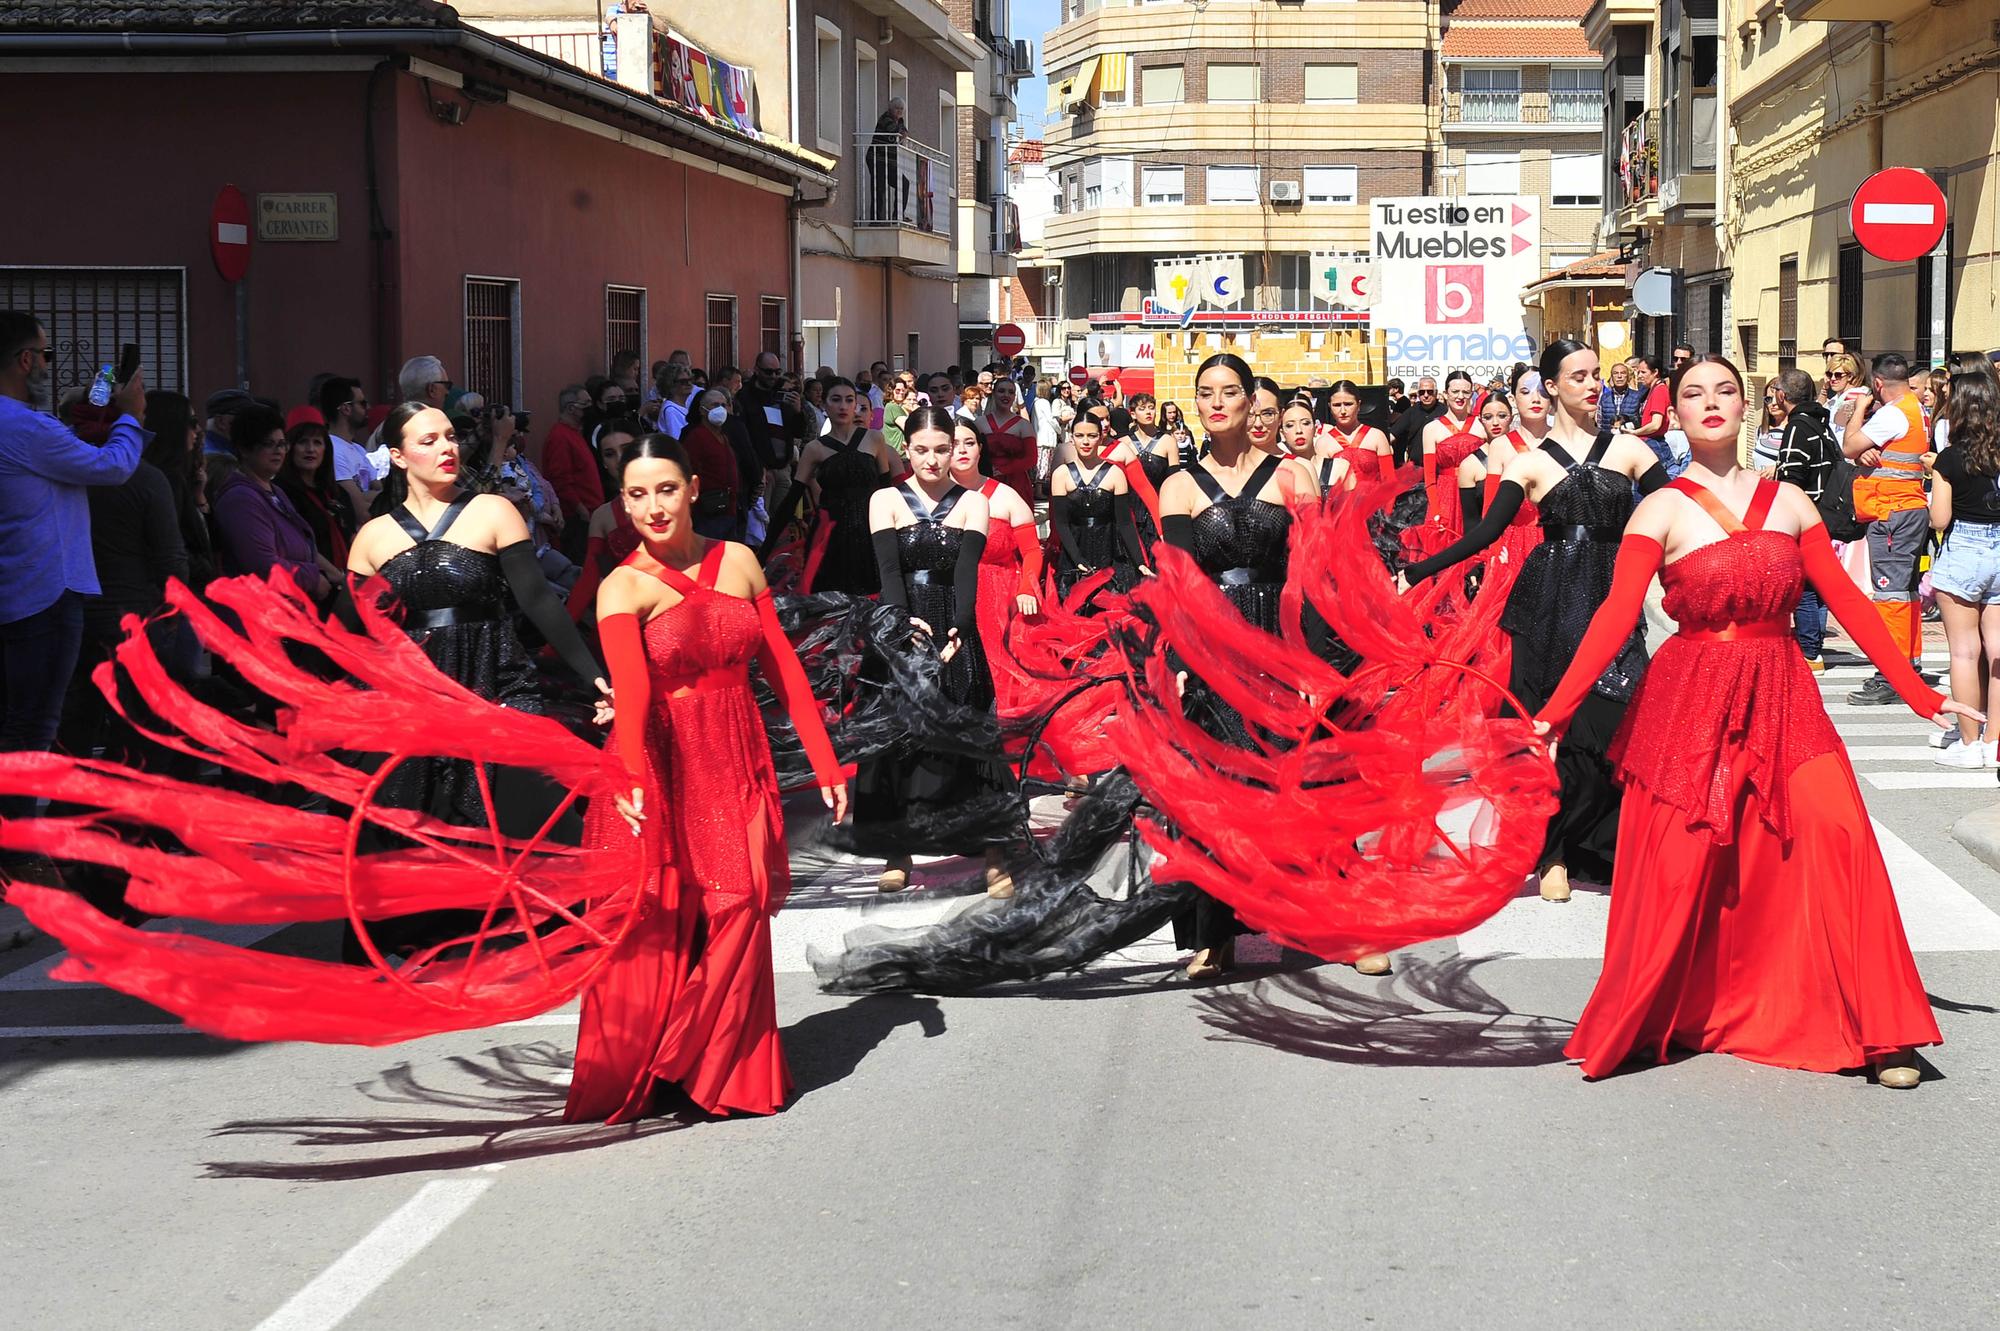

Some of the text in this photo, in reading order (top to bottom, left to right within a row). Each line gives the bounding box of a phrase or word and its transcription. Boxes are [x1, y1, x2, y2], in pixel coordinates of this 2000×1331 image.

[275, 201, 328, 214] CARRER
[1377, 203, 1504, 225] Tu estilo en
[266, 219, 329, 235] CERVANTES
[1376, 230, 1507, 259] Muebles
[1436, 267, 1473, 322] b
[1250, 312, 1342, 321] SCHOOL OF ENGLISH
[1386, 365, 1441, 377] UEBLES
